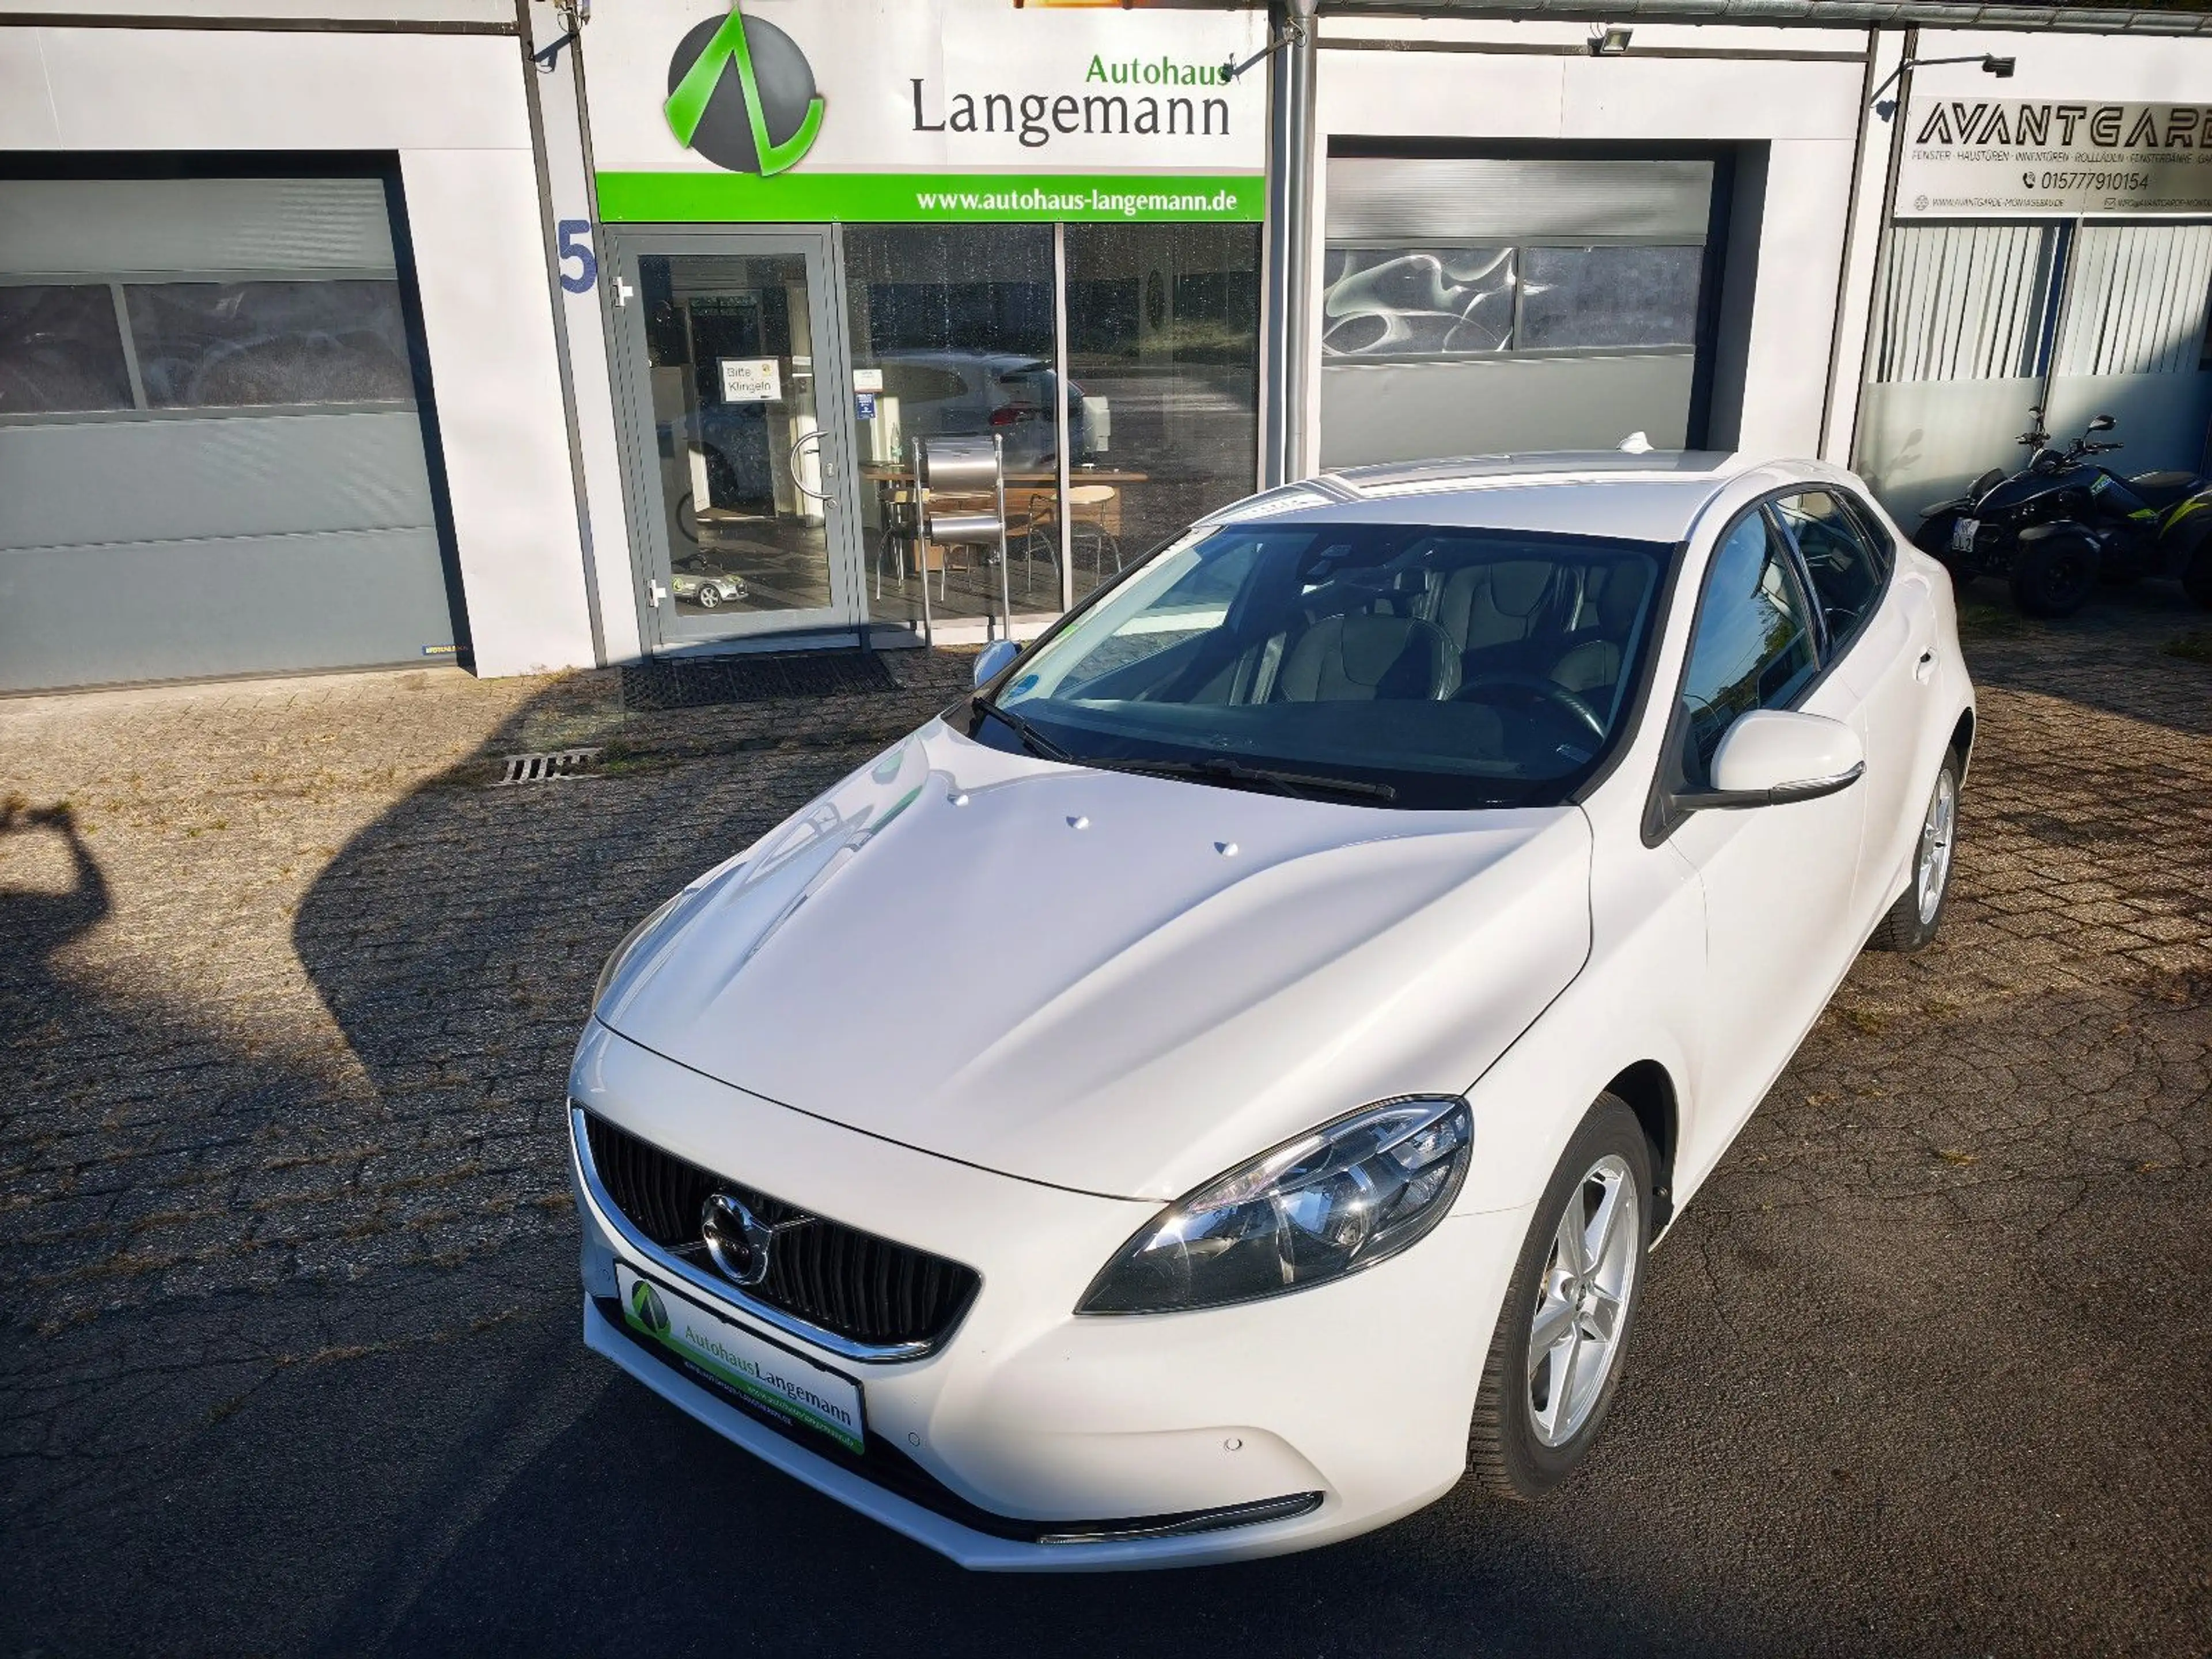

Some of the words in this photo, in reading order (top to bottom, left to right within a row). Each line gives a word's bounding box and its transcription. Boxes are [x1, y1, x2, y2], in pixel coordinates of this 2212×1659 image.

[910, 78, 1230, 147] Langemann
[2042, 172, 2149, 190] 015777910154
[916, 188, 1237, 215] www.autohaus-langemann.de
[558, 219, 597, 294] 5
[728, 368, 751, 377] Bitte
[728, 381, 771, 393] Klingeln
